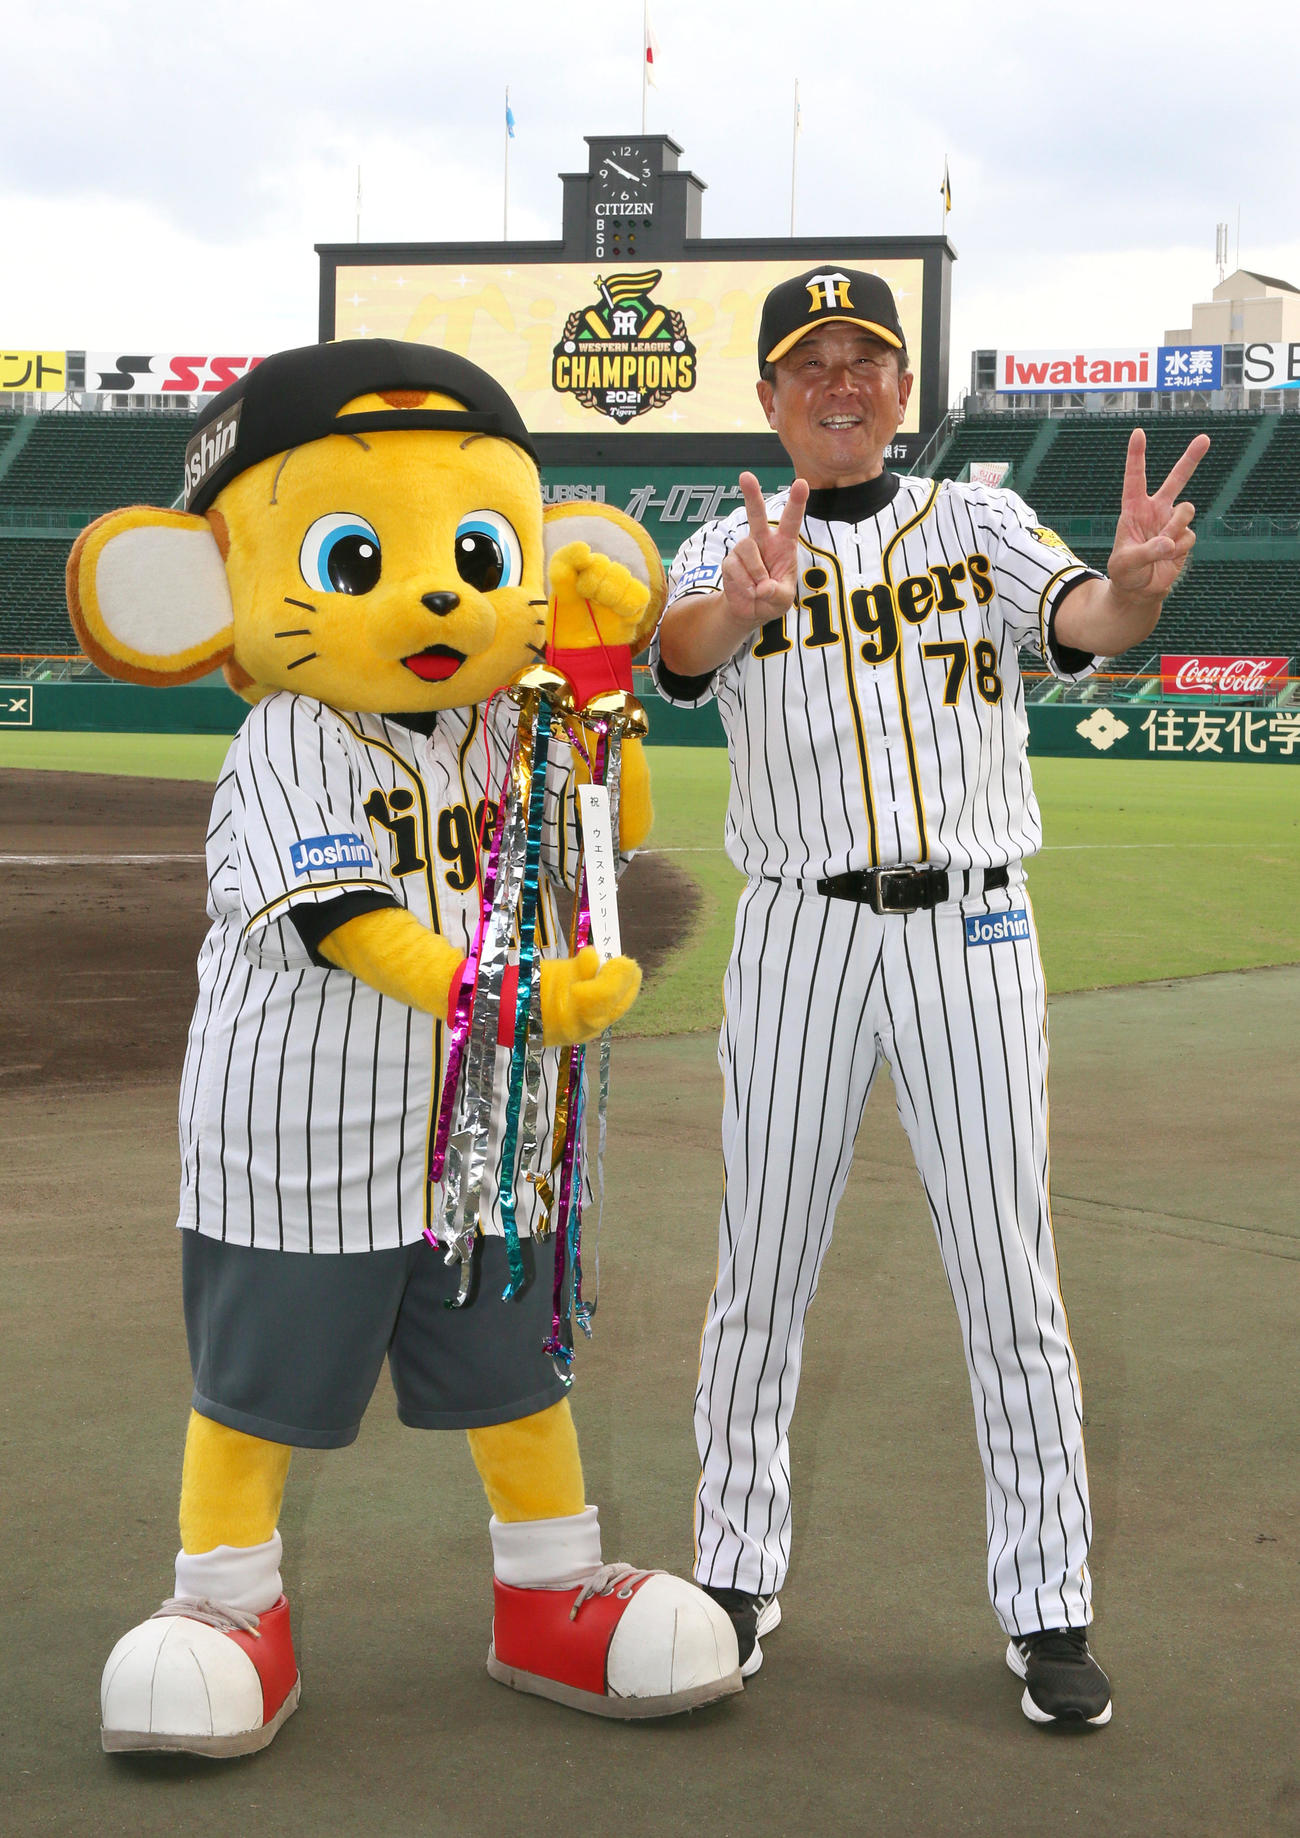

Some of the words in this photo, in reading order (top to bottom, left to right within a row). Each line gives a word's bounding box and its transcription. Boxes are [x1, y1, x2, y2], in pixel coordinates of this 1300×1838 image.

[620, 147, 631, 156] 12
[599, 169, 608, 178] 9
[642, 169, 651, 177] 3
[620, 191, 629, 200] 6
[595, 203, 653, 215] CITIZEN
[578, 342, 629, 352] WESTERN
[631, 342, 671, 352] LEAGUE
[0, 354, 63, 388] ント
[161, 356, 266, 391] SS
[556, 355, 693, 389] CHAMPIONS
[1004, 352, 1149, 385] Iwatani
[1164, 350, 1213, 375] 水素
[1164, 375, 1213, 387] エネルギー
[606, 391, 641, 403] 2021
[610, 406, 637, 417] Tigers
[184, 420, 238, 499] oshin
[923, 638, 1004, 706] 78
[1176, 659, 1272, 692] Coca-Cola
[1140, 708, 1300, 755] 住友化学
[590, 796, 600, 807] 祝
[295, 837, 370, 869] Joshin
[969, 913, 1028, 942] Joshin
